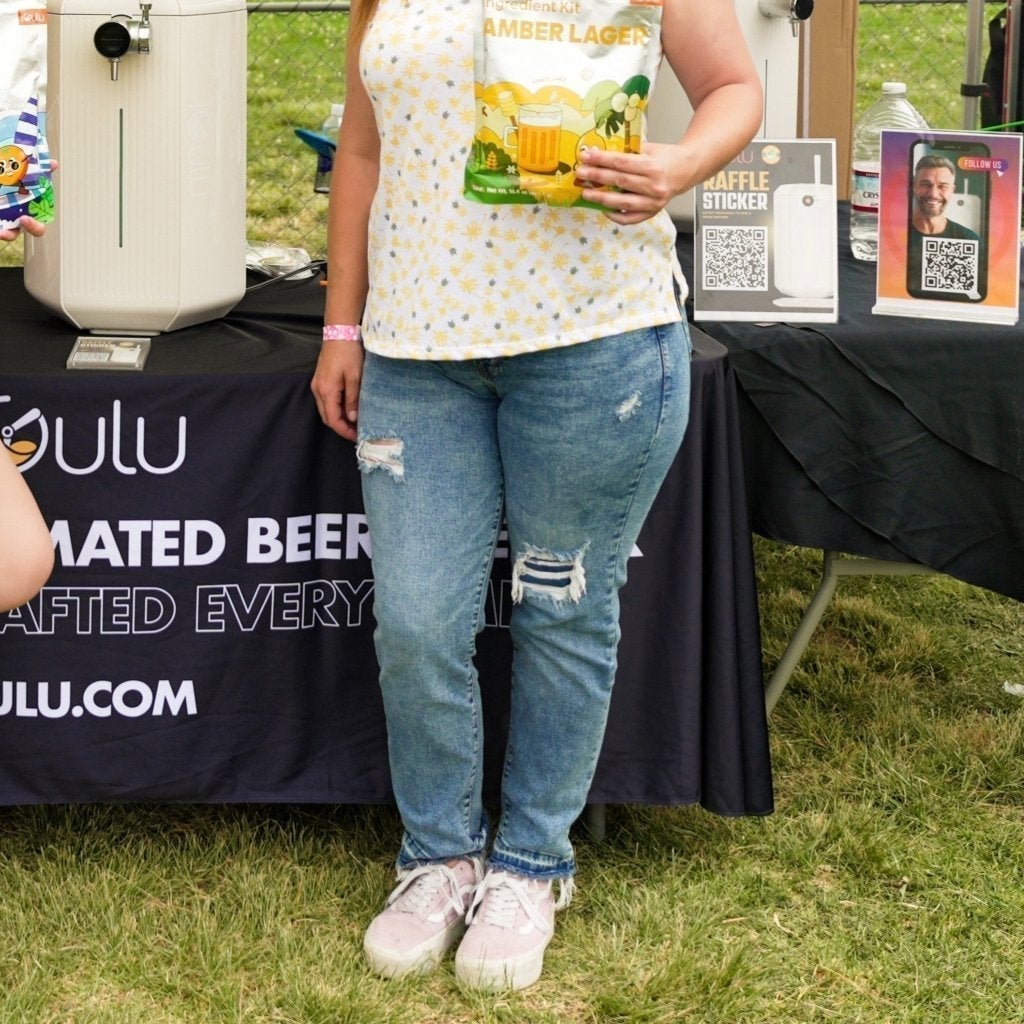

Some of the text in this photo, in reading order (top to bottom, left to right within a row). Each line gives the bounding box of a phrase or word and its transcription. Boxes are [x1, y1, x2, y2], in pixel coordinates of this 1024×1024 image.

[559, 1, 581, 14] Kit
[483, 17, 650, 47] AMBER LAGER
[964, 158, 1002, 170] FOLLOW US
[703, 171, 770, 192] RAFFLE
[702, 192, 769, 211] STICKER
[862, 191, 880, 200] CRYS
[48, 519, 226, 567] MATED
[246, 512, 372, 564] BEER
[195, 579, 375, 633] EVERY
